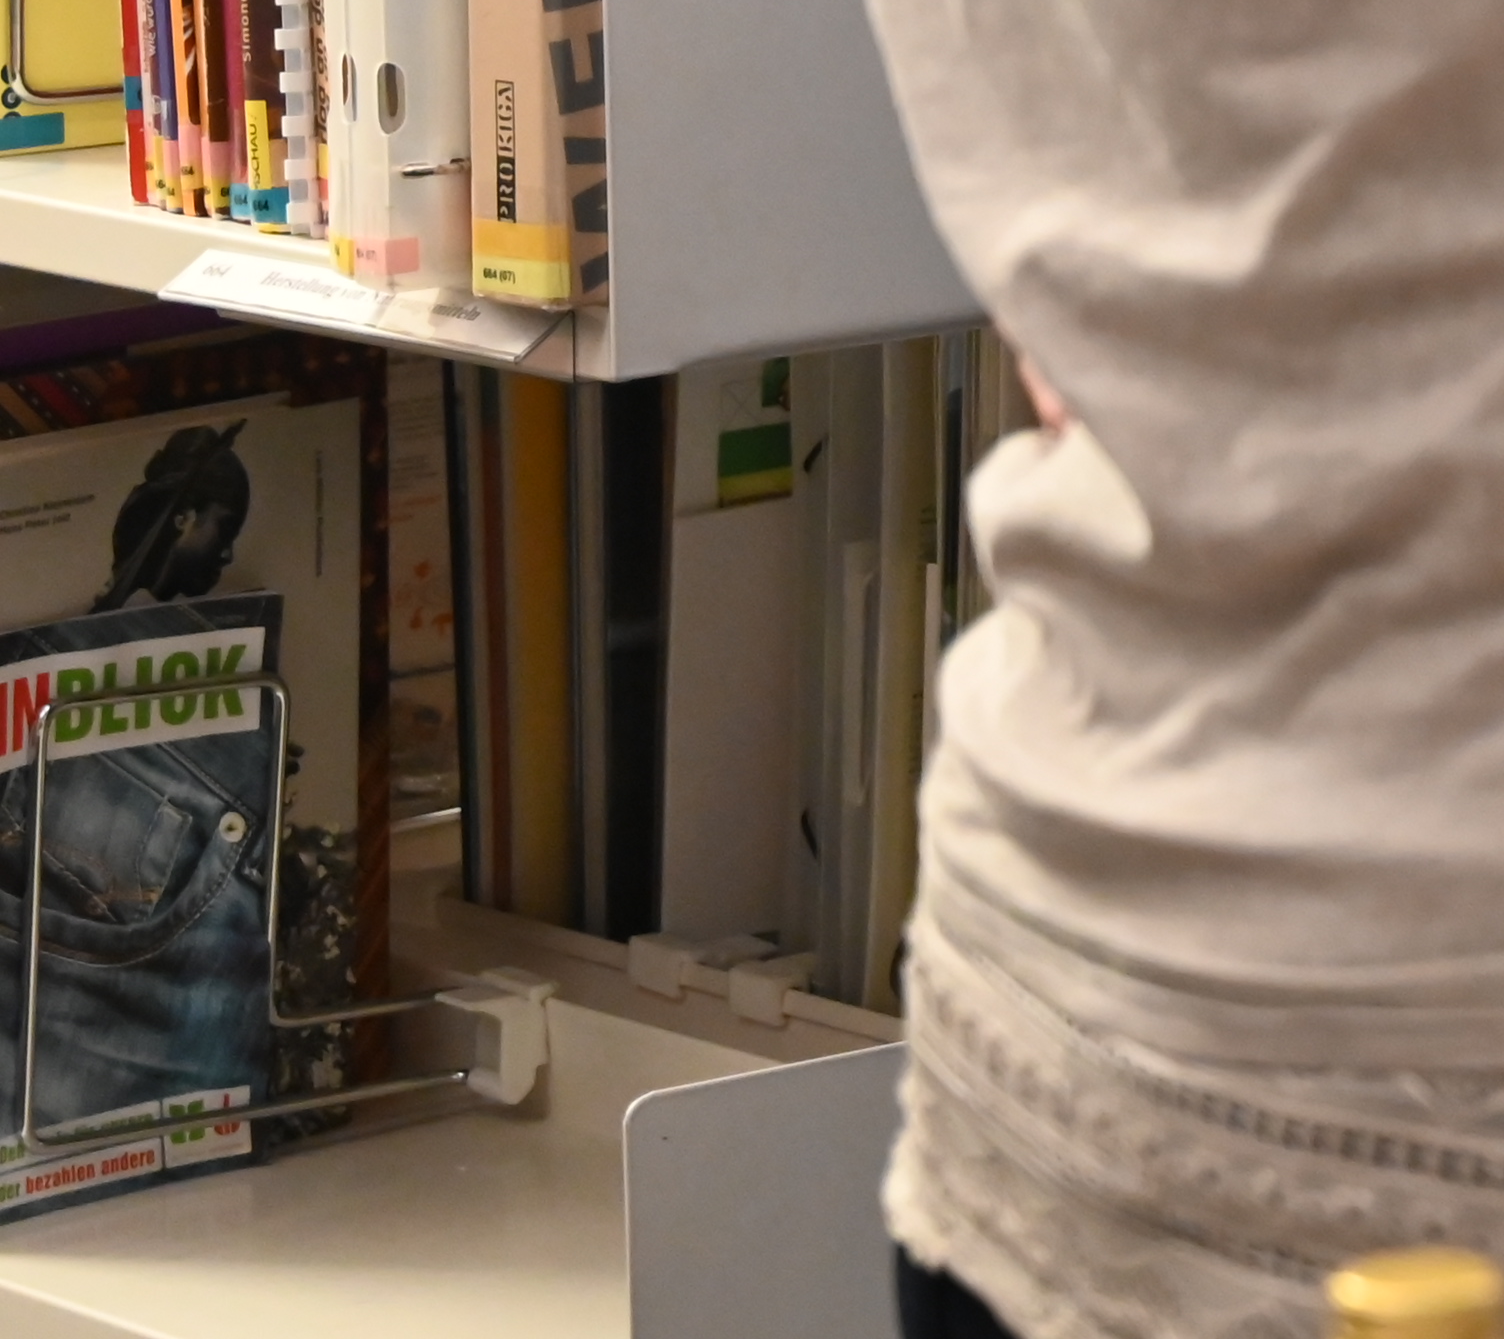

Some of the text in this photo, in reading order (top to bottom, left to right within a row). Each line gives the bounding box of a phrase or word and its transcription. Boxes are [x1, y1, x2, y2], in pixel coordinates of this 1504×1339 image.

[260, 271, 334, 298] Herstellung
[26, 1163, 96, 1194] bezahlen
[101, 1148, 156, 1175] andere
